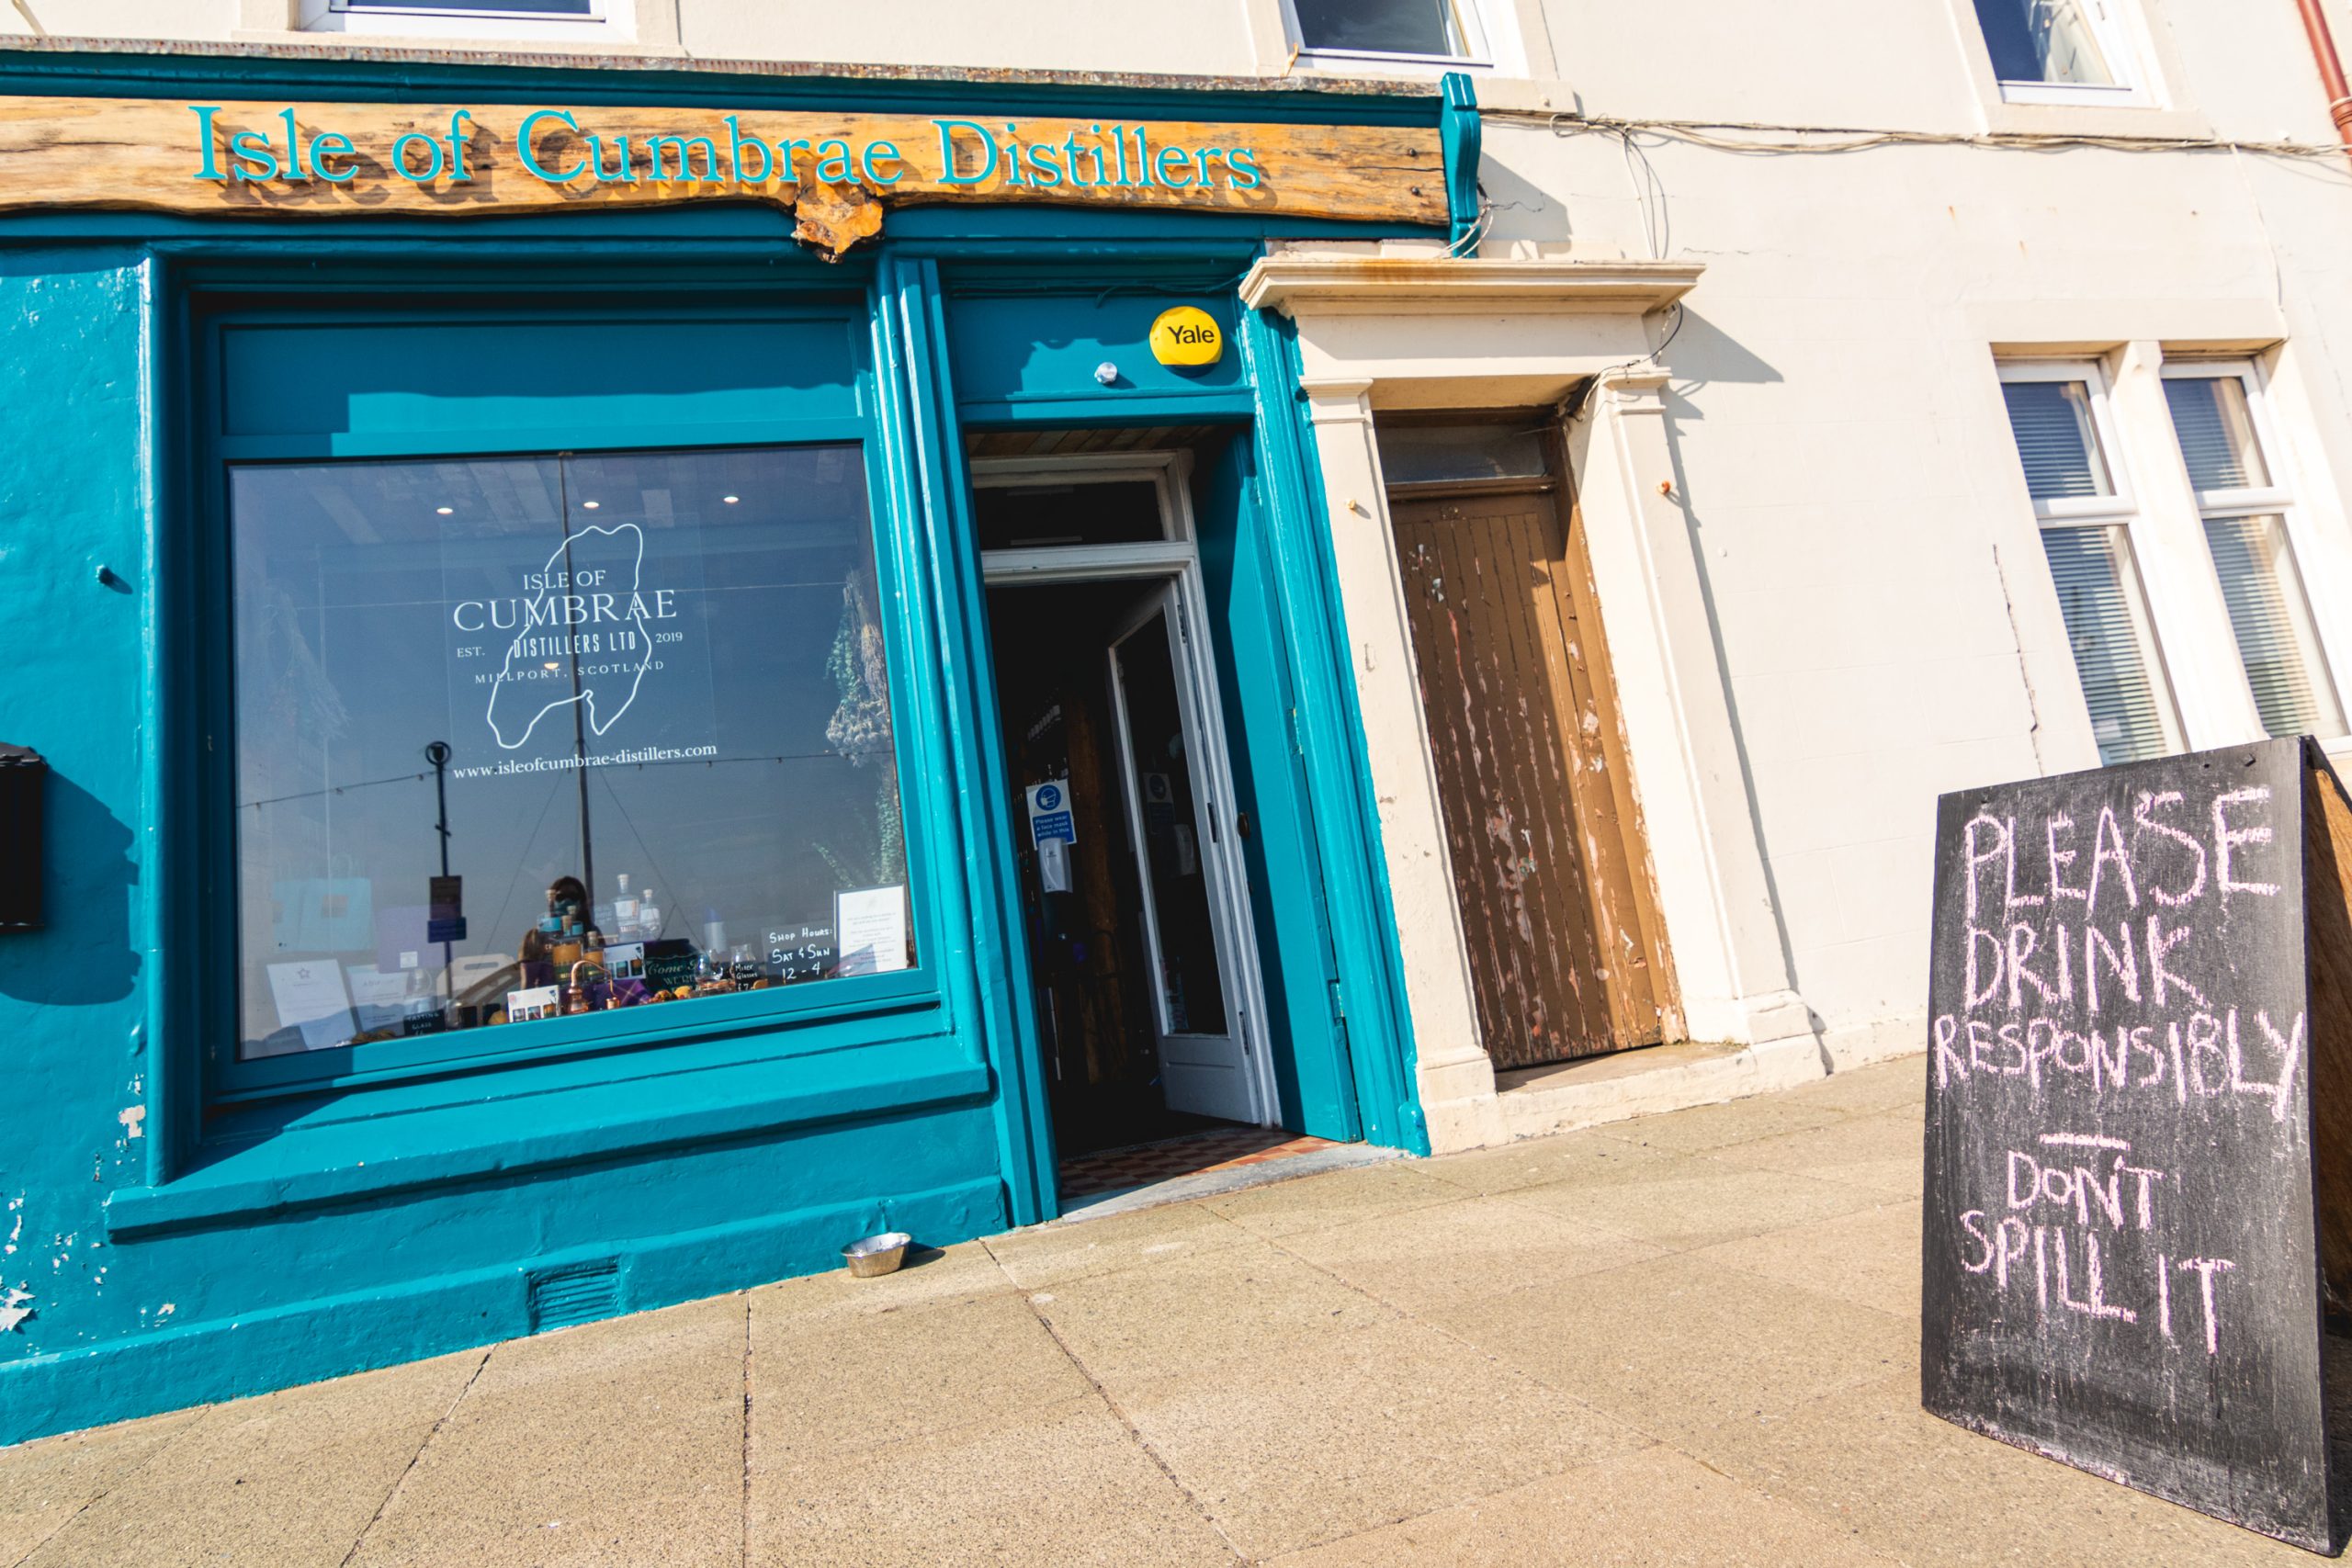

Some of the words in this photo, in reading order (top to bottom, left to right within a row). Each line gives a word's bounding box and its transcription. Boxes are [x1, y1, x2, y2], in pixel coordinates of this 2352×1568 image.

[187, 105, 360, 183] Isle
[391, 109, 472, 182] of
[516, 108, 905, 185] Cumbrae
[932, 118, 1261, 189] Distillers
[1167, 324, 1215, 344] Yale
[523, 571, 570, 591] ISLE
[576, 570, 606, 587] OF
[453, 589, 678, 631] CUMBRAE
[457, 646, 485, 658] EST.
[514, 634, 600, 659] DISTILLERS
[610, 631, 636, 652] LTD
[655, 631, 684, 643] 2019
[577, 660, 664, 676] SCOTLAND
[453, 744, 718, 779] www.isleofcumbrae-distillers.com
[1964, 784, 2281, 921] PLEASE
[769, 931, 796, 943] SHOP
[782, 967, 797, 980] 12
[811, 962, 820, 976] 4
[1964, 914, 2212, 1010] DRINK
[1934, 1010, 2303, 1120] RESPONSIBLY
[1960, 1210, 2137, 1324] SPILL
[2158, 1252, 2236, 1355] IT
